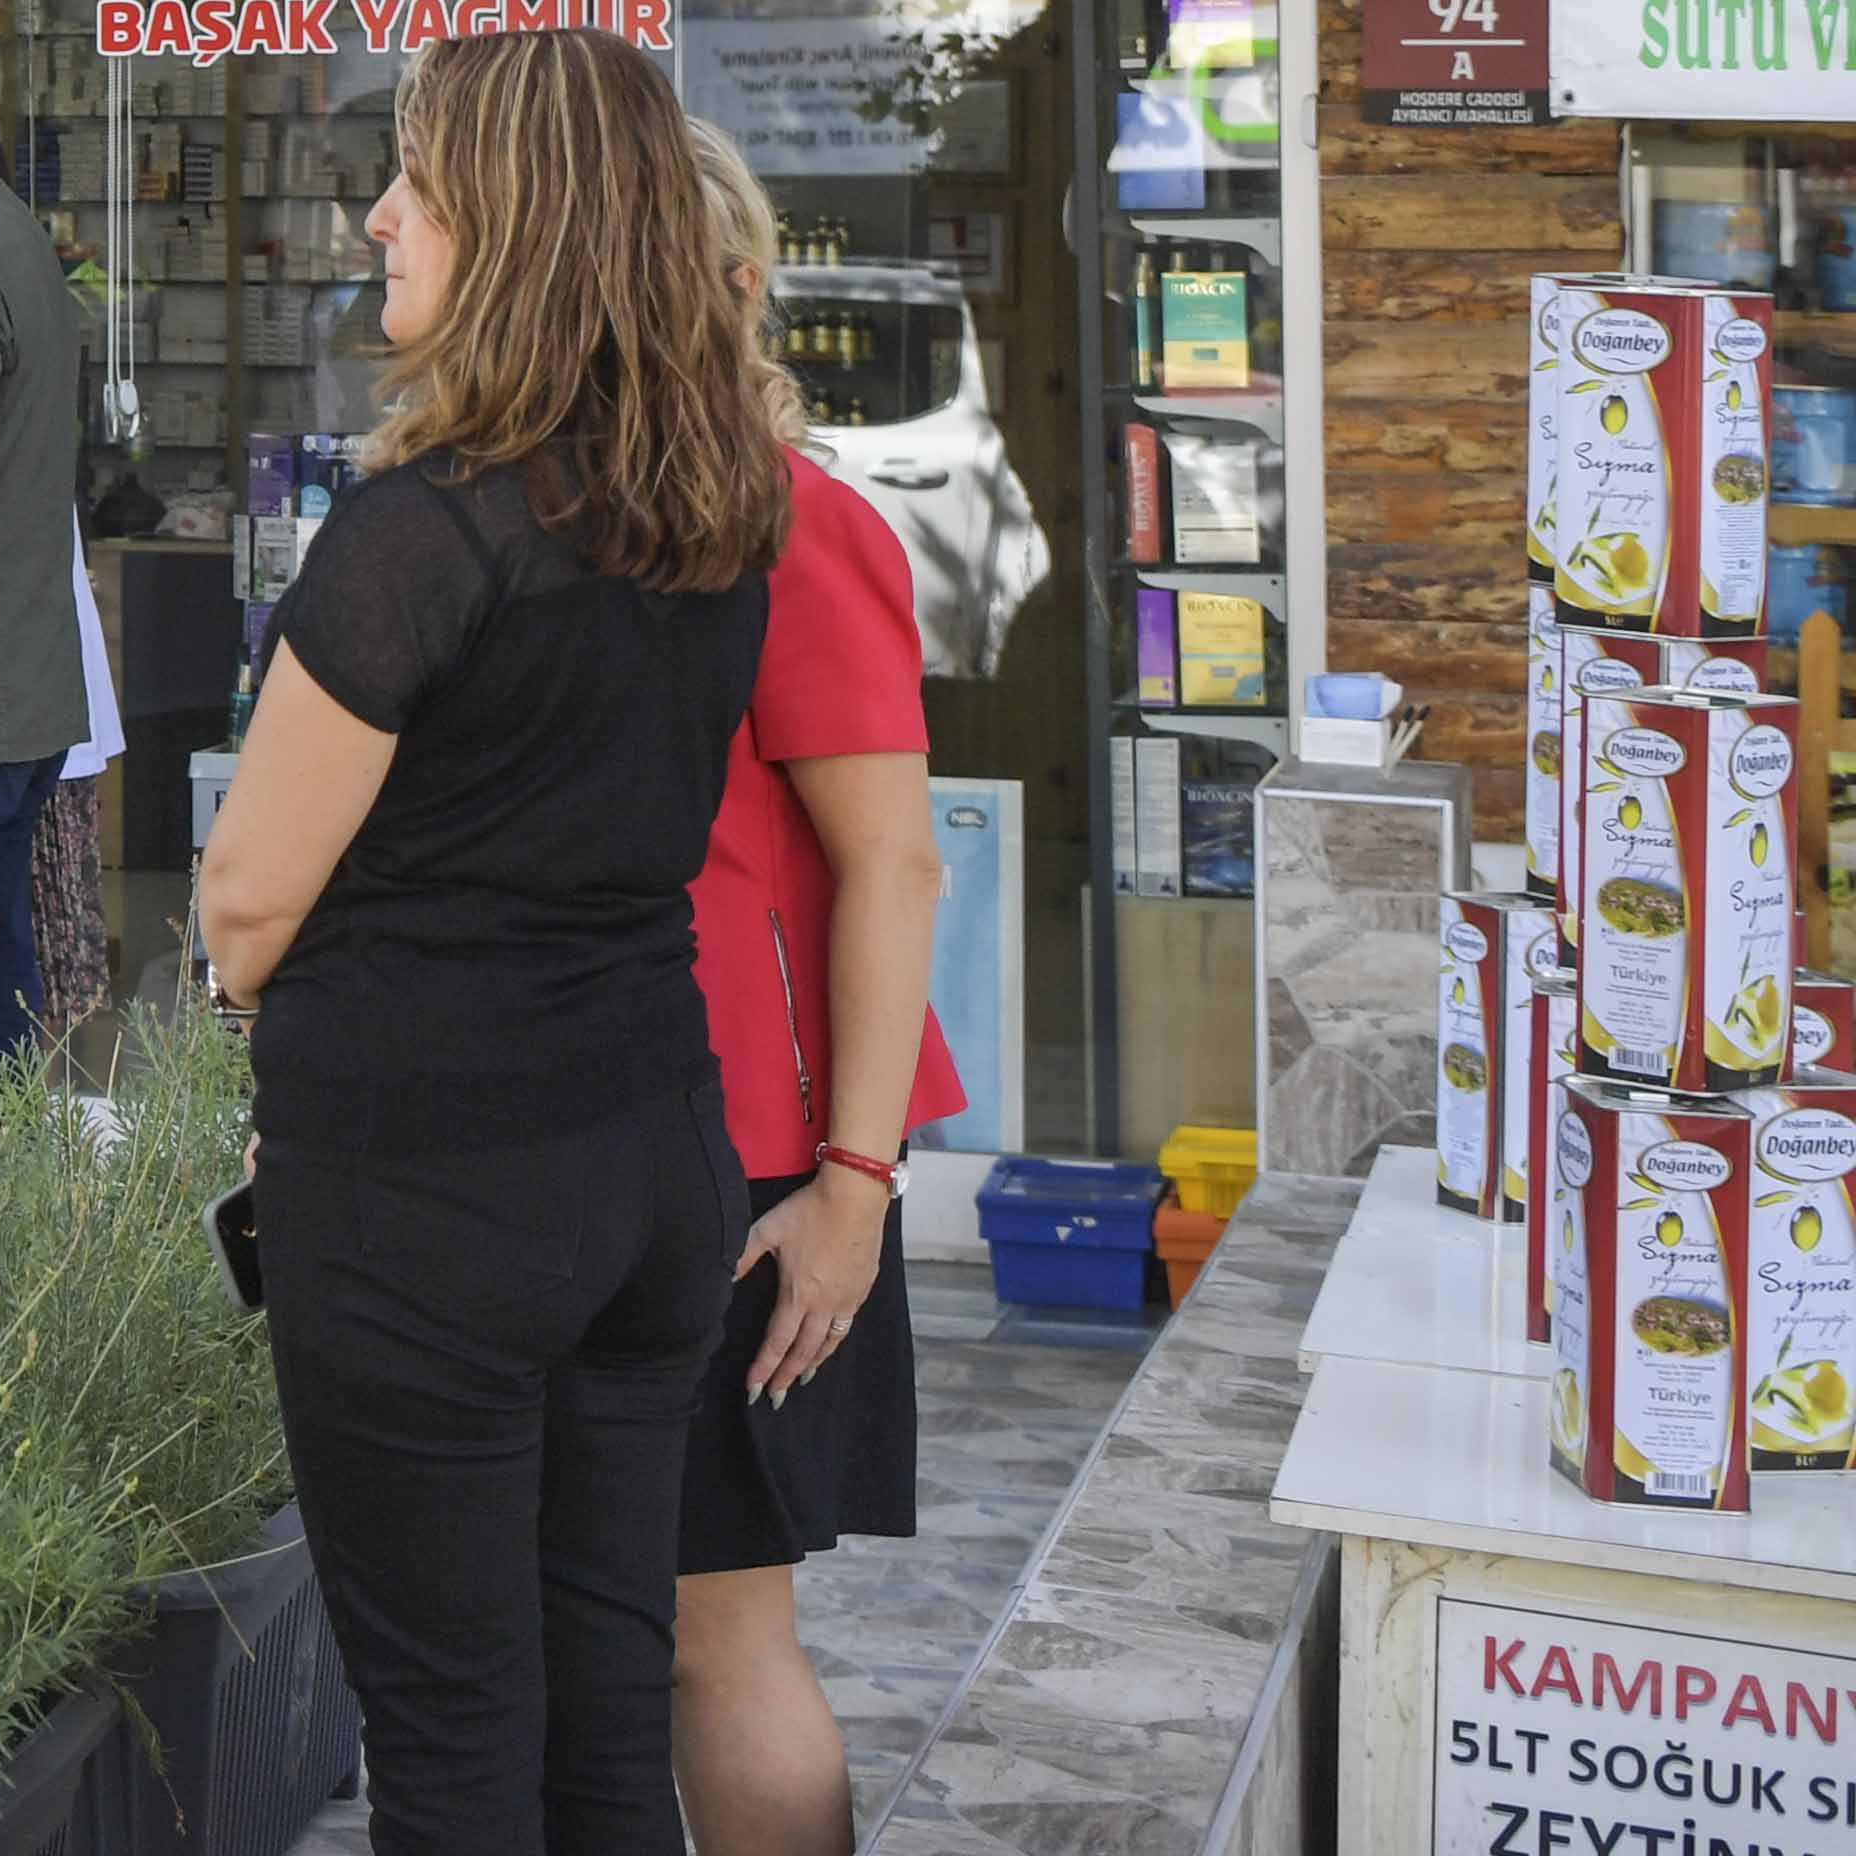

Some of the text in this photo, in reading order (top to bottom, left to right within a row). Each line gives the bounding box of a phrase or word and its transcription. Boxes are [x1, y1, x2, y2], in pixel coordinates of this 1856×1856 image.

[1452, 51, 1475, 80] A
[1400, 90, 1525, 106] HOŞDERE CADDESİ
[1392, 106, 1534, 122] AYRANCI MAHALLESİ
[1581, 330, 1665, 355] Doğanbey
[1611, 743, 1681, 765] Doğanbey
[1610, 964, 1667, 986] Türkiye
[1766, 1135, 1856, 1159] Doğanbey
[1647, 1157, 1726, 1177] Doğanbey
[1757, 1262, 1855, 1312] Sızma
[1649, 1387, 1713, 1407] Türkiye
[1450, 1719, 1550, 1774] 5LT
[1569, 1740, 1786, 1815] SOĞUK
